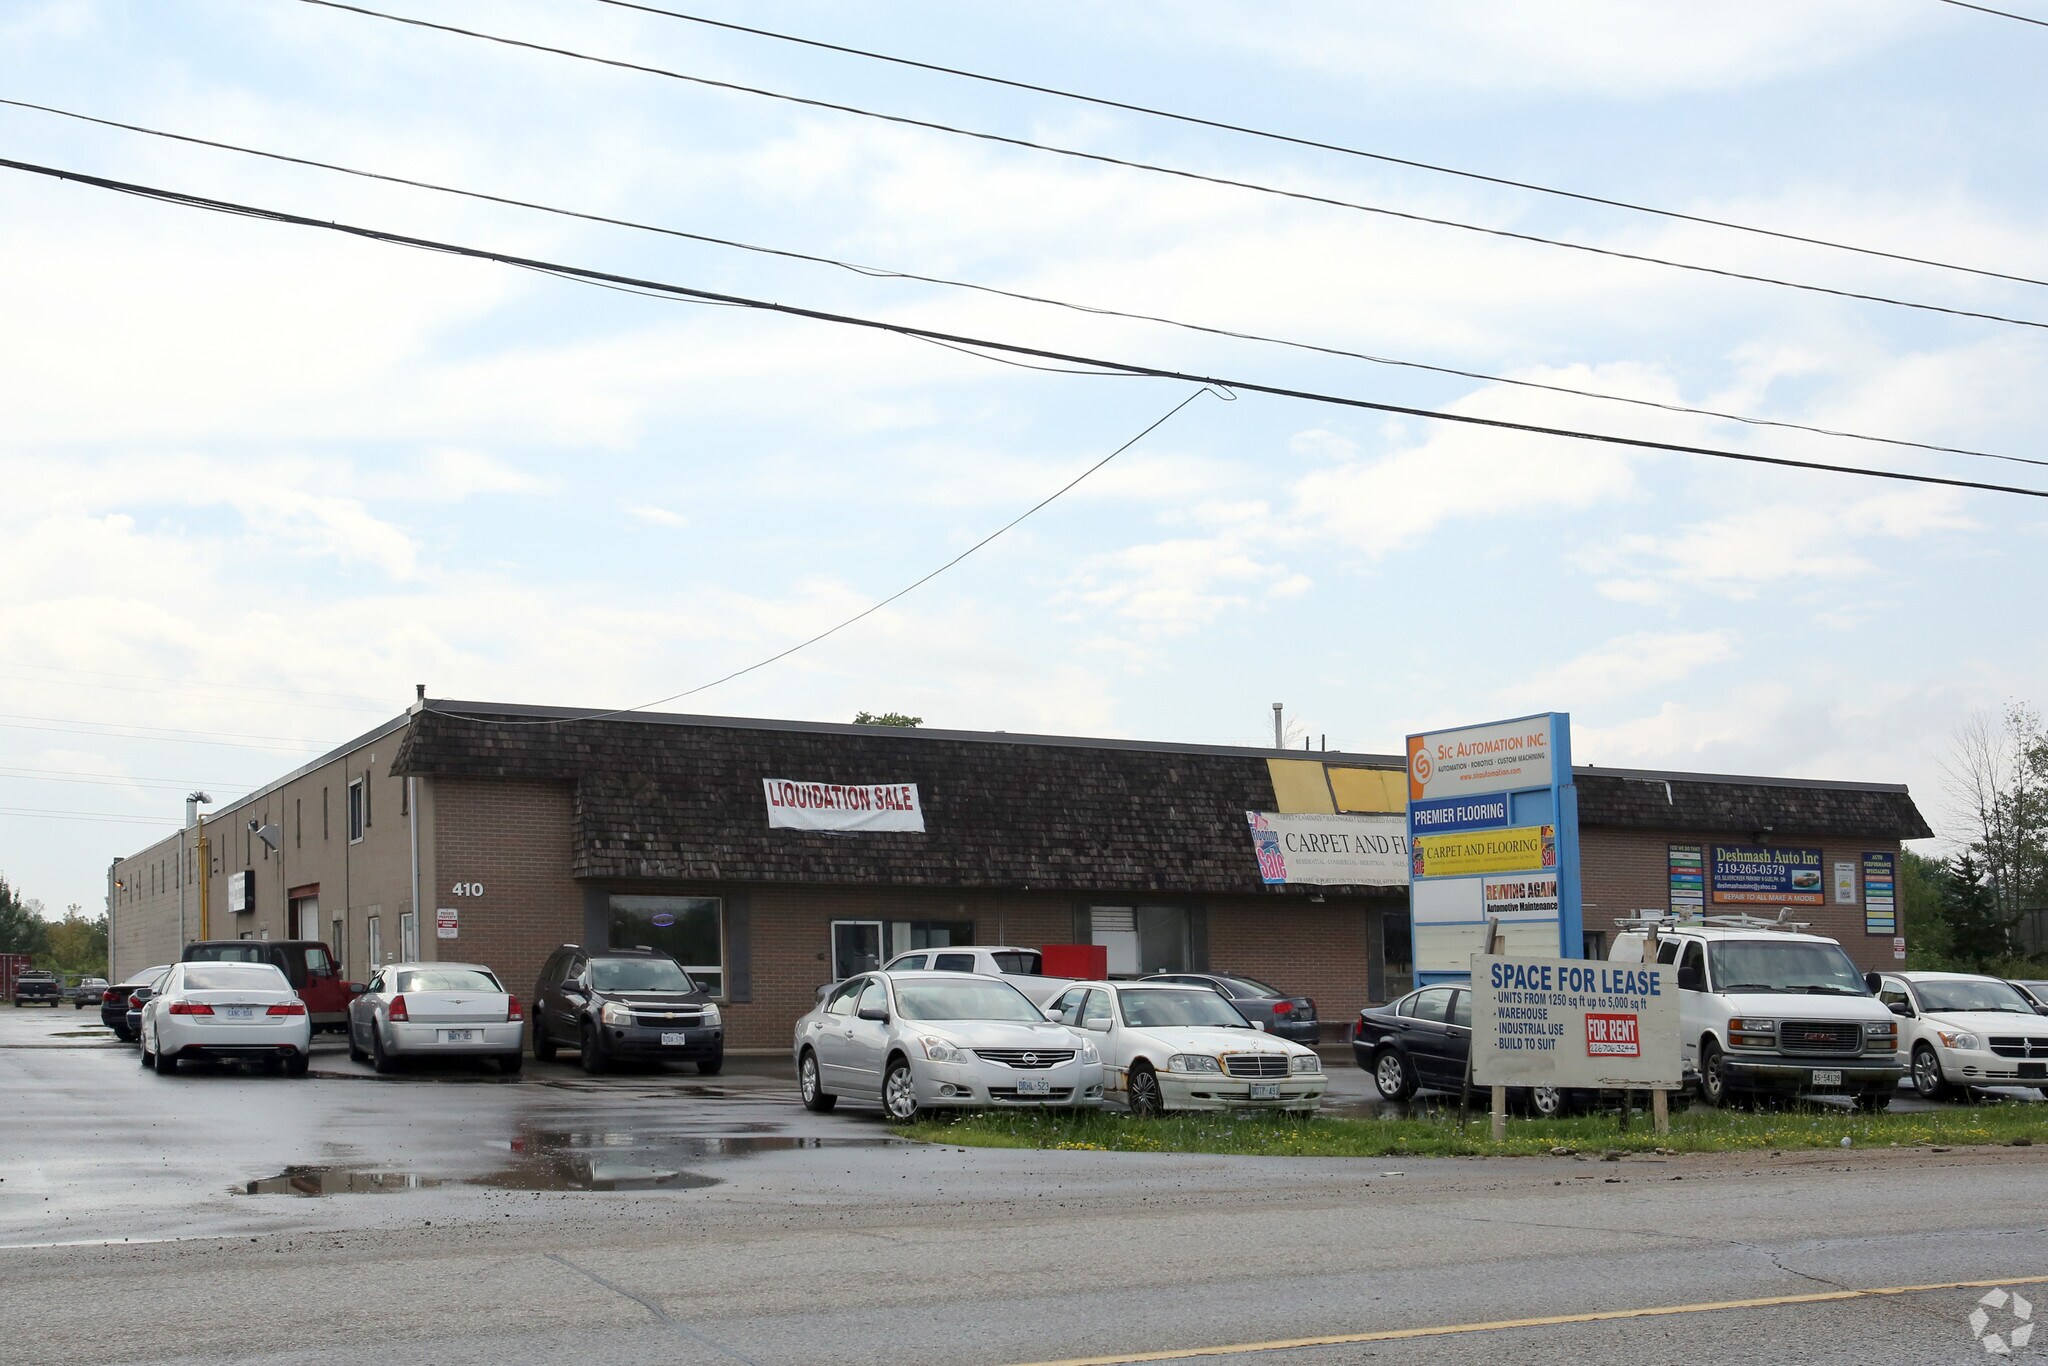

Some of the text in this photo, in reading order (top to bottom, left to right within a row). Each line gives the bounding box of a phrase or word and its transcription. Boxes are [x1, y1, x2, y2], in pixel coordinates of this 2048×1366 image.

[1456, 736, 1523, 757] AUTOMATION
[1527, 733, 1547, 748] INC.
[1438, 752, 1545, 773] AUTOMATION ROBOTICS CUSTOM MACHINING
[1460, 767, 1521, 781] www.sicautomation.com
[768, 782, 914, 811] LIQUIDATION SALE
[1414, 802, 1504, 826] PREMIER FLOORING
[1251, 828, 1279, 843] Flooring
[1285, 832, 1408, 854] CARPET AND FL
[1427, 845, 1463, 859] CARPET
[1464, 841, 1485, 856] AND
[1487, 838, 1538, 855] FLOORING
[1716, 847, 1819, 865] Deshmash Auto Inc
[1256, 847, 1287, 879] Sale
[1717, 863, 1785, 875] 519-265-0579
[452, 882, 484, 897] 410
[1527, 880, 1557, 899] AGAIN
[1487, 901, 1558, 913] Automotive Maintenance
[1491, 962, 1661, 996] SPACE FOR LEASE
[1498, 991, 1647, 1012] UNITS FROM 1250 sq ft up to 5,000 sq ft
[1498, 1007, 1547, 1020] WAREHOUSE
[1499, 1022, 1564, 1036] INDUSTRIAL USE
[1588, 1019, 1636, 1042] FOR RENT
[1499, 1037, 1556, 1050] BUILD TO SUIT
[1037, 1081, 1049, 1091] 523
